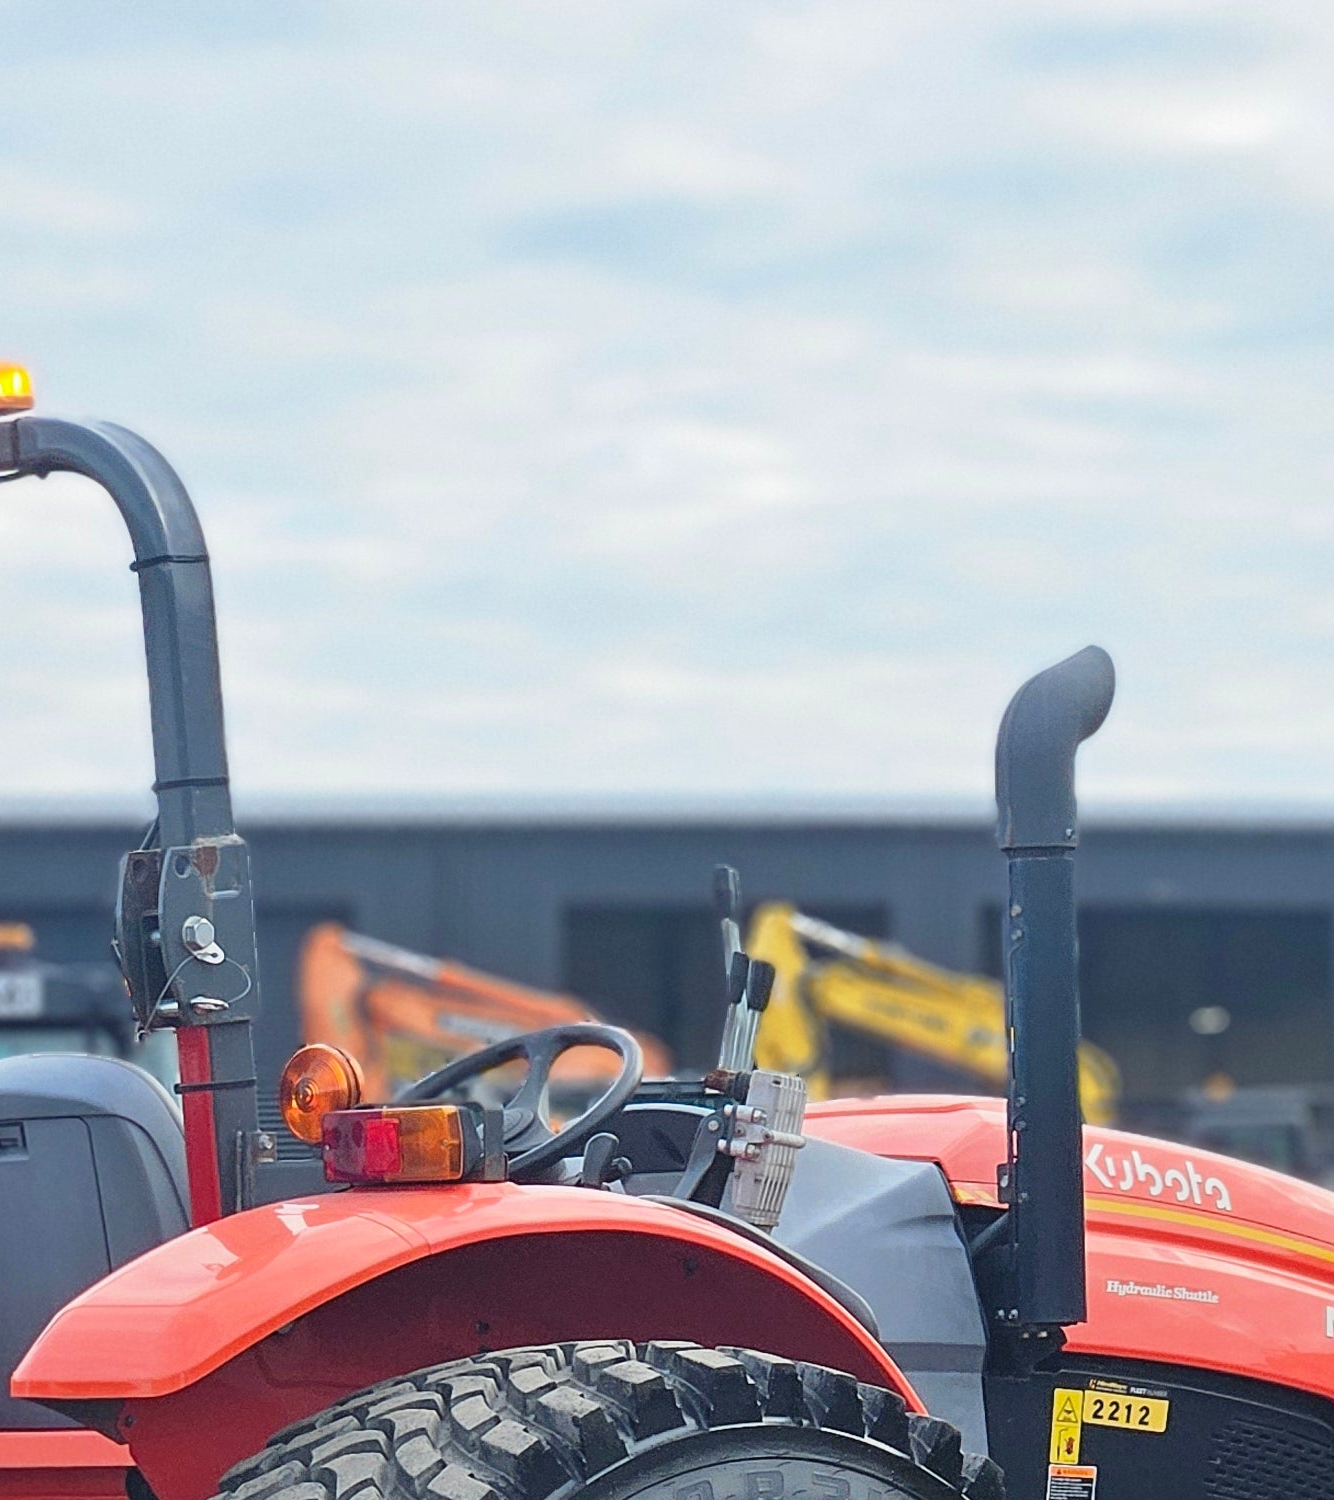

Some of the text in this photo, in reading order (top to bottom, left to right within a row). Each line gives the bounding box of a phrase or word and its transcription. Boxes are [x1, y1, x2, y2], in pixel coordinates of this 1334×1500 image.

[1085, 1143, 1232, 1211] Kubota
[1106, 1280, 1219, 1303] Hydraulic Shuttle
[1092, 1399, 1150, 1426] 2212
